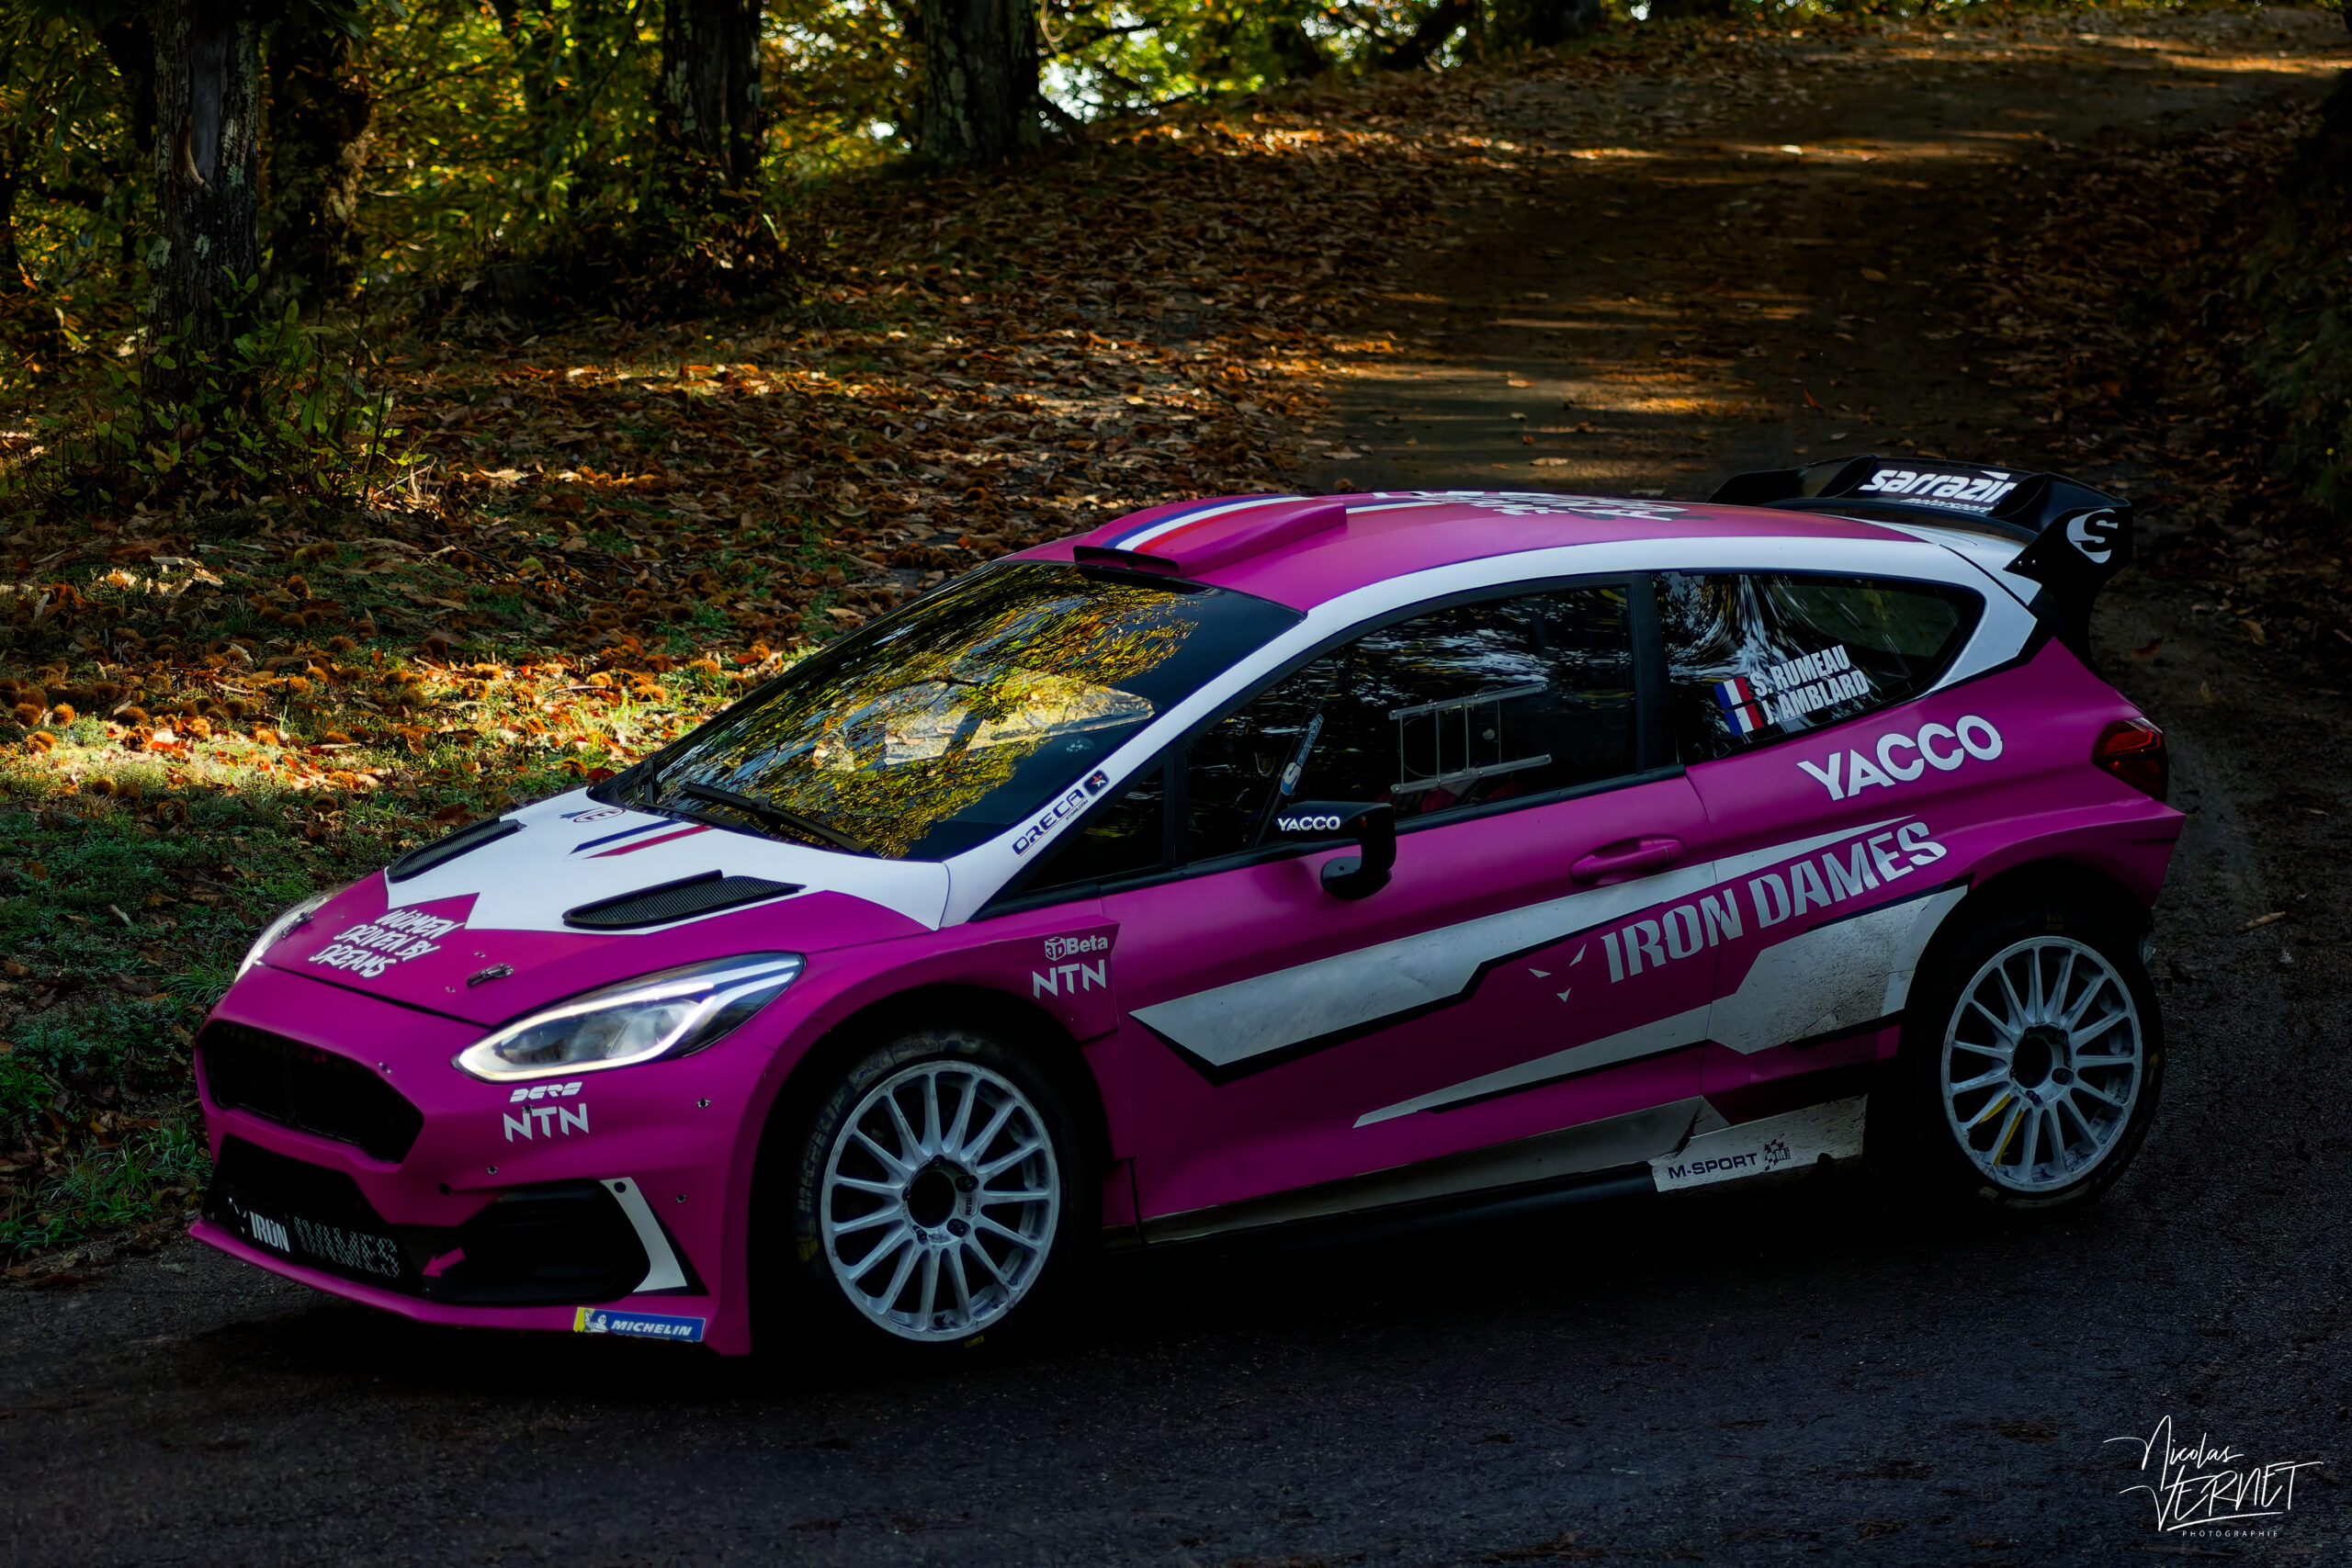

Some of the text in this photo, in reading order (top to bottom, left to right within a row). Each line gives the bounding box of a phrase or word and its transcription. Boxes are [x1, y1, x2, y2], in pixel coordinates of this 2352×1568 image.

[1771, 644, 1851, 691] RUMEAU
[1779, 670, 1870, 720] AMBLARD
[1796, 715, 2003, 802] YACCO
[1012, 788, 1085, 855] ORECA
[1277, 816, 1340, 831] YACCO
[1600, 822, 1947, 984] IRON DAMES
[334, 924, 441, 962] DRIVEN BY
[375, 909, 465, 940] WOMEN
[309, 944, 397, 977] DREAMS
[1032, 959, 1106, 999] NTN
[503, 1102, 590, 1143] NTN
[1668, 1153, 1758, 1179] M-SPORT
[249, 1211, 290, 1253] IRON
[611, 1320, 693, 1337] MICHELIN
